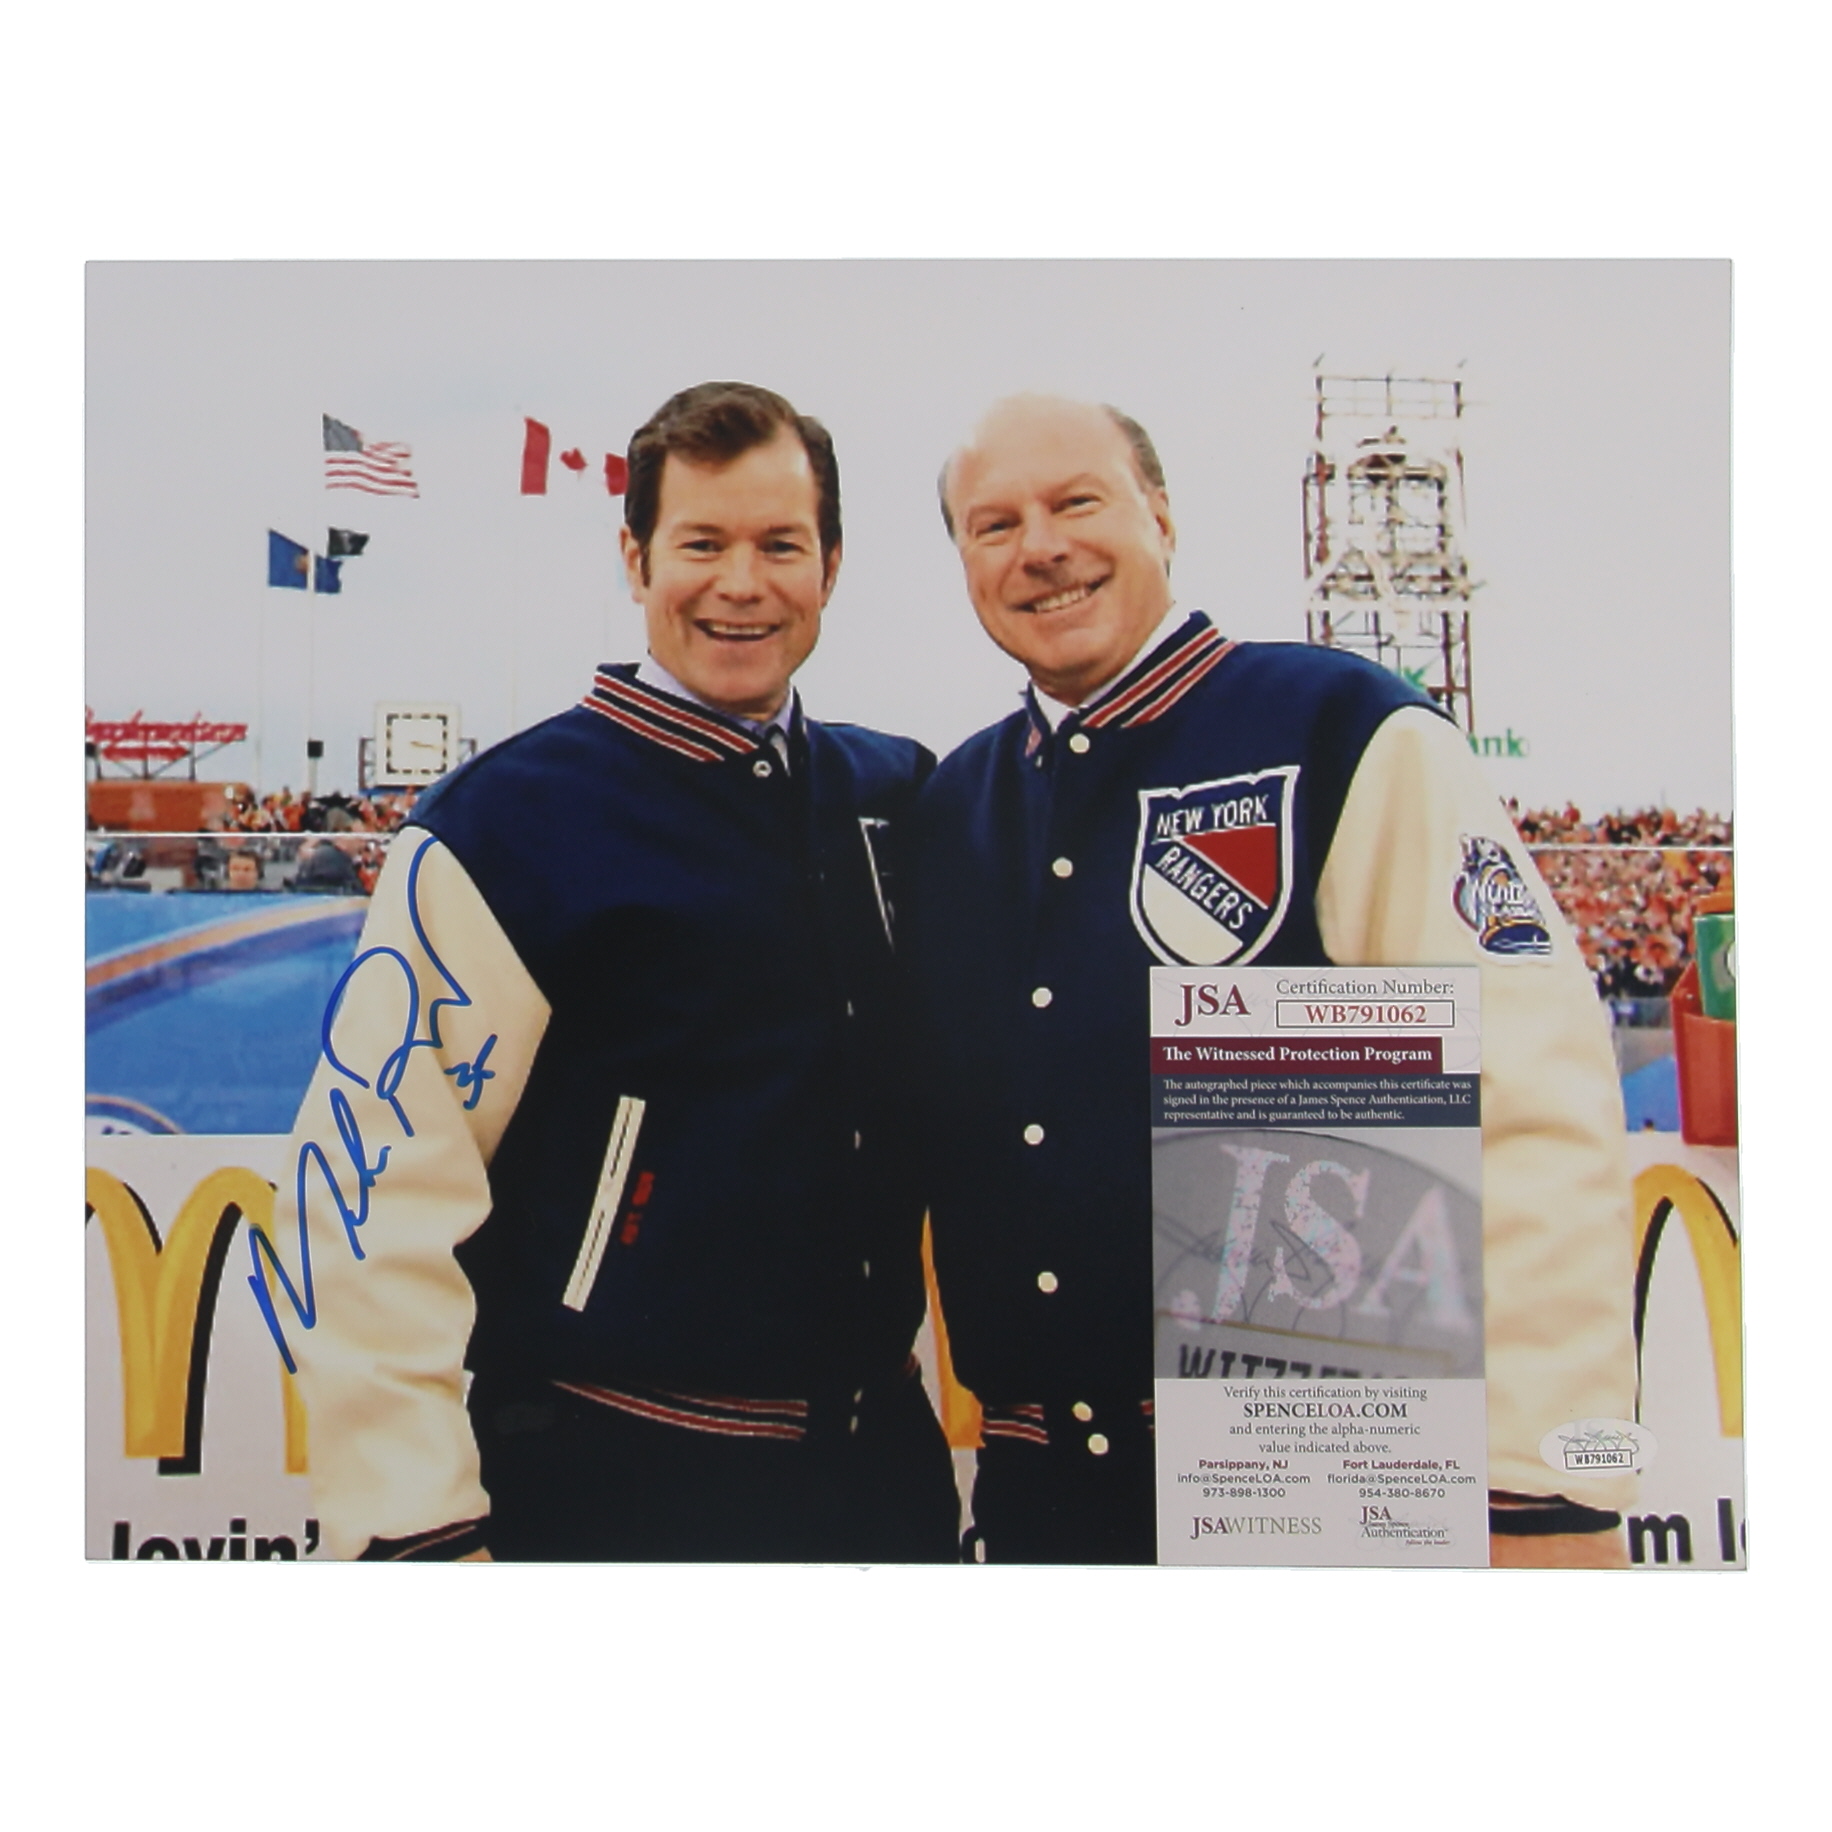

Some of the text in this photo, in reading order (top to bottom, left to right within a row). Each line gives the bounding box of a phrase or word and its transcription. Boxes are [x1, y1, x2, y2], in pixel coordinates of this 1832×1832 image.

[1157, 793, 1269, 835] NEW YORK
[1155, 846, 1253, 930] RANGERS
[1276, 978, 1455, 995] Certification Number:
[1174, 984, 1251, 1027] JSA
[1305, 1004, 1427, 1024] WB791062
[1163, 1046, 1432, 1065] The Witnessed Protection Program
[1163, 1079, 1472, 1093] The autographed piece which accompanies this certificate was
[1163, 1094, 1197, 1107] signed
[1199, 1095, 1210, 1105] in
[1211, 1094, 1228, 1105] the
[1231, 1096, 1276, 1107] presence
[1277, 1094, 1289, 1105] of
[1298, 1094, 1328, 1106] James
[1330, 1094, 1366, 1107] Spence
[1368, 1094, 1447, 1105] Authentication,
[1449, 1094, 1471, 1105] LLC
[1164, 1109, 1405, 1122] representative and is guaranteed to be authentic.
[1171, 1144, 1473, 1335] JSA
[1223, 1386, 1427, 1401] Verify this certification by visiting
[1243, 1402, 1407, 1418] SPENCELOA.COM
[1229, 1423, 1420, 1438] and entering the alpha-numeric
[1259, 1441, 1391, 1453] value indicated above.
[1199, 1459, 1288, 1471] Parsippany, NJ
[1343, 1459, 1460, 1471] Fort Lauderdale, FL
[1574, 1453, 1625, 1465] WB791062
[1178, 1473, 1311, 1484] info@SpenceLOA.com
[1327, 1474, 1476, 1485] florida@SpenceLOA.com
[1203, 1487, 1285, 1498] 973-898-1300
[1359, 1488, 1445, 1498] 954-380-8670
[1359, 1505, 1392, 1525] JSA
